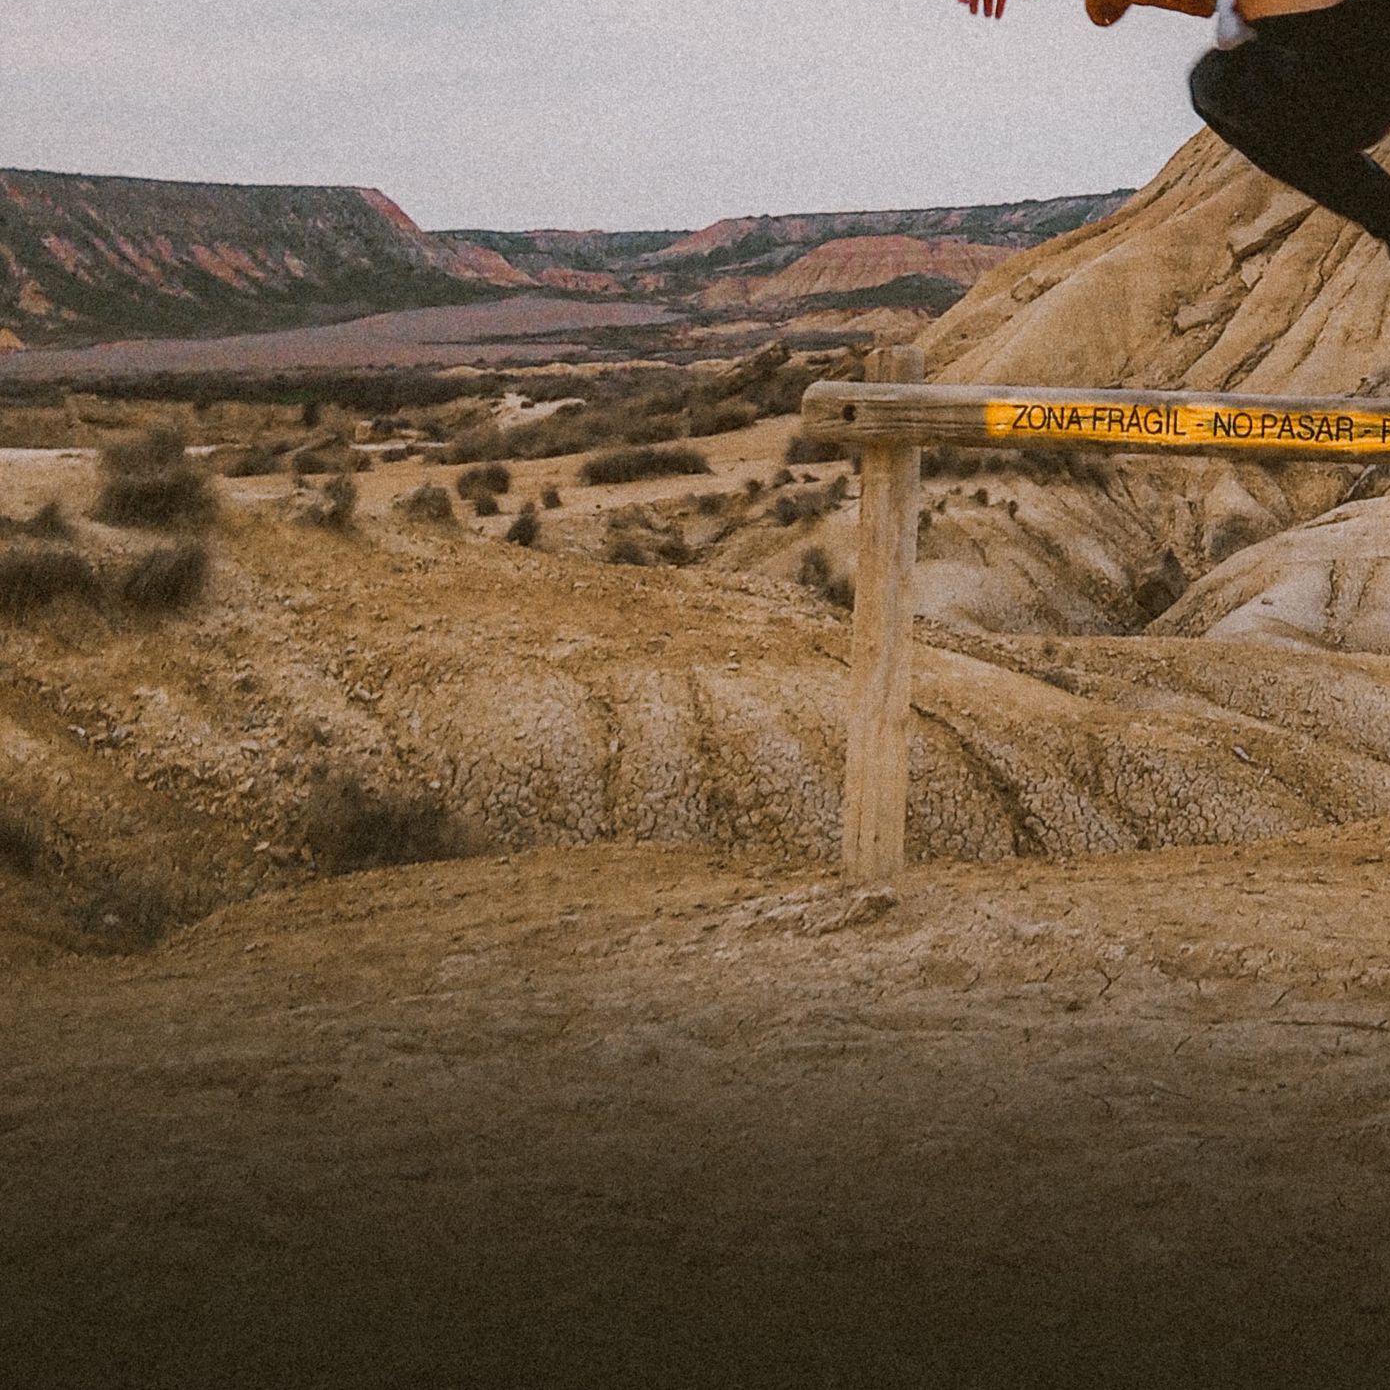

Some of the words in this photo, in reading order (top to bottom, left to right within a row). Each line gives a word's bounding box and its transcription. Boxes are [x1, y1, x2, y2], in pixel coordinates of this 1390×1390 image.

[1012, 405, 1083, 430] ZONA
[1092, 404, 1187, 436] FRÁGIL
[1213, 411, 1254, 438] NO
[1261, 415, 1355, 442] PASAR
